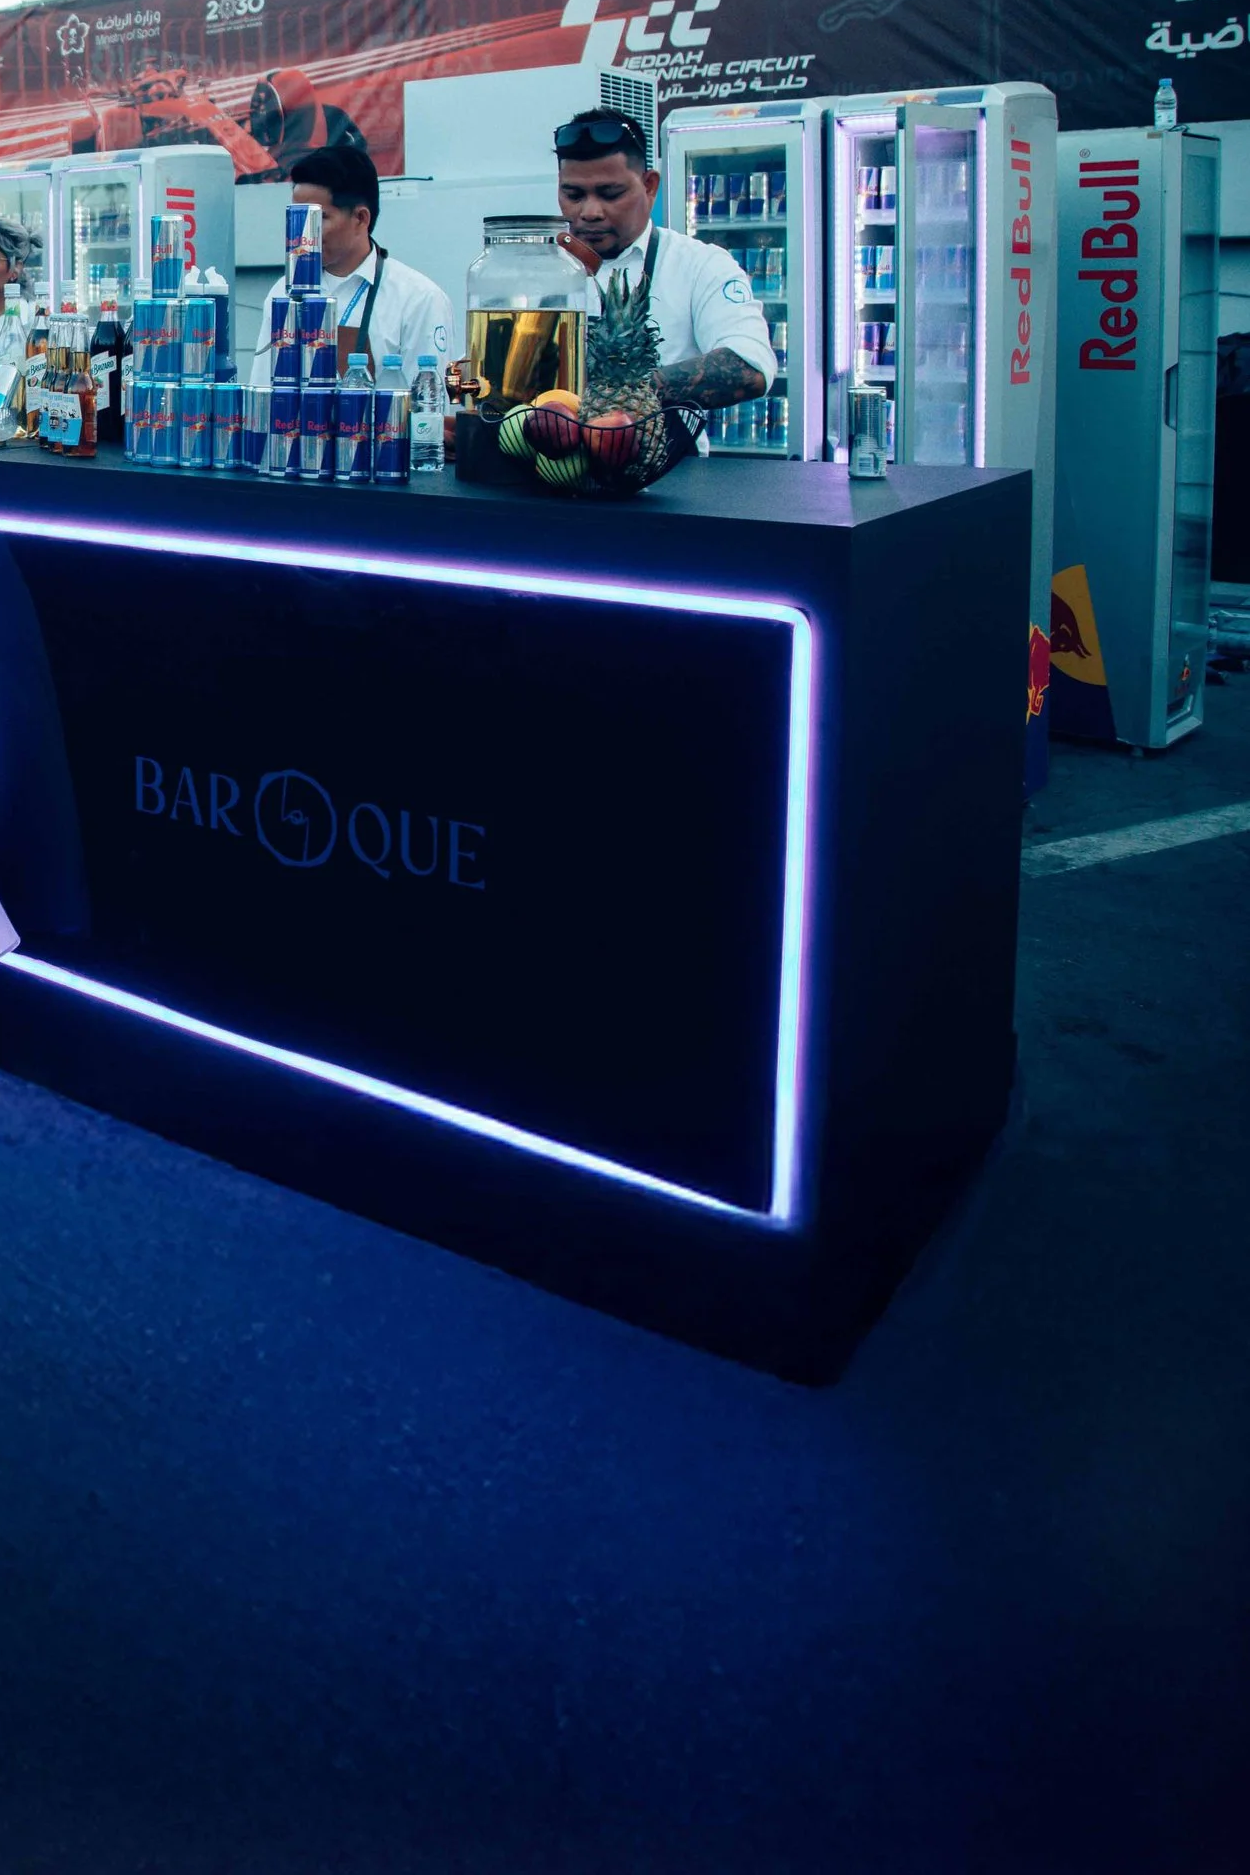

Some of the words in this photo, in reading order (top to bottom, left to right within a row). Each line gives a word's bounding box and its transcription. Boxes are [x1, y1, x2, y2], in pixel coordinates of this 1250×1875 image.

[725, 54, 816, 75] CIRCUIT
[1144, 14, 1250, 60] ضية
[1010, 139, 1032, 255] Bull
[1079, 159, 1141, 259] Bull
[1010, 267, 1032, 385] Red
[1078, 269, 1139, 371] Red
[275, 418, 295, 431] Red
[307, 420, 328, 432] Red
[340, 421, 359, 433] Red
[135, 754, 486, 890] BAROQUE
